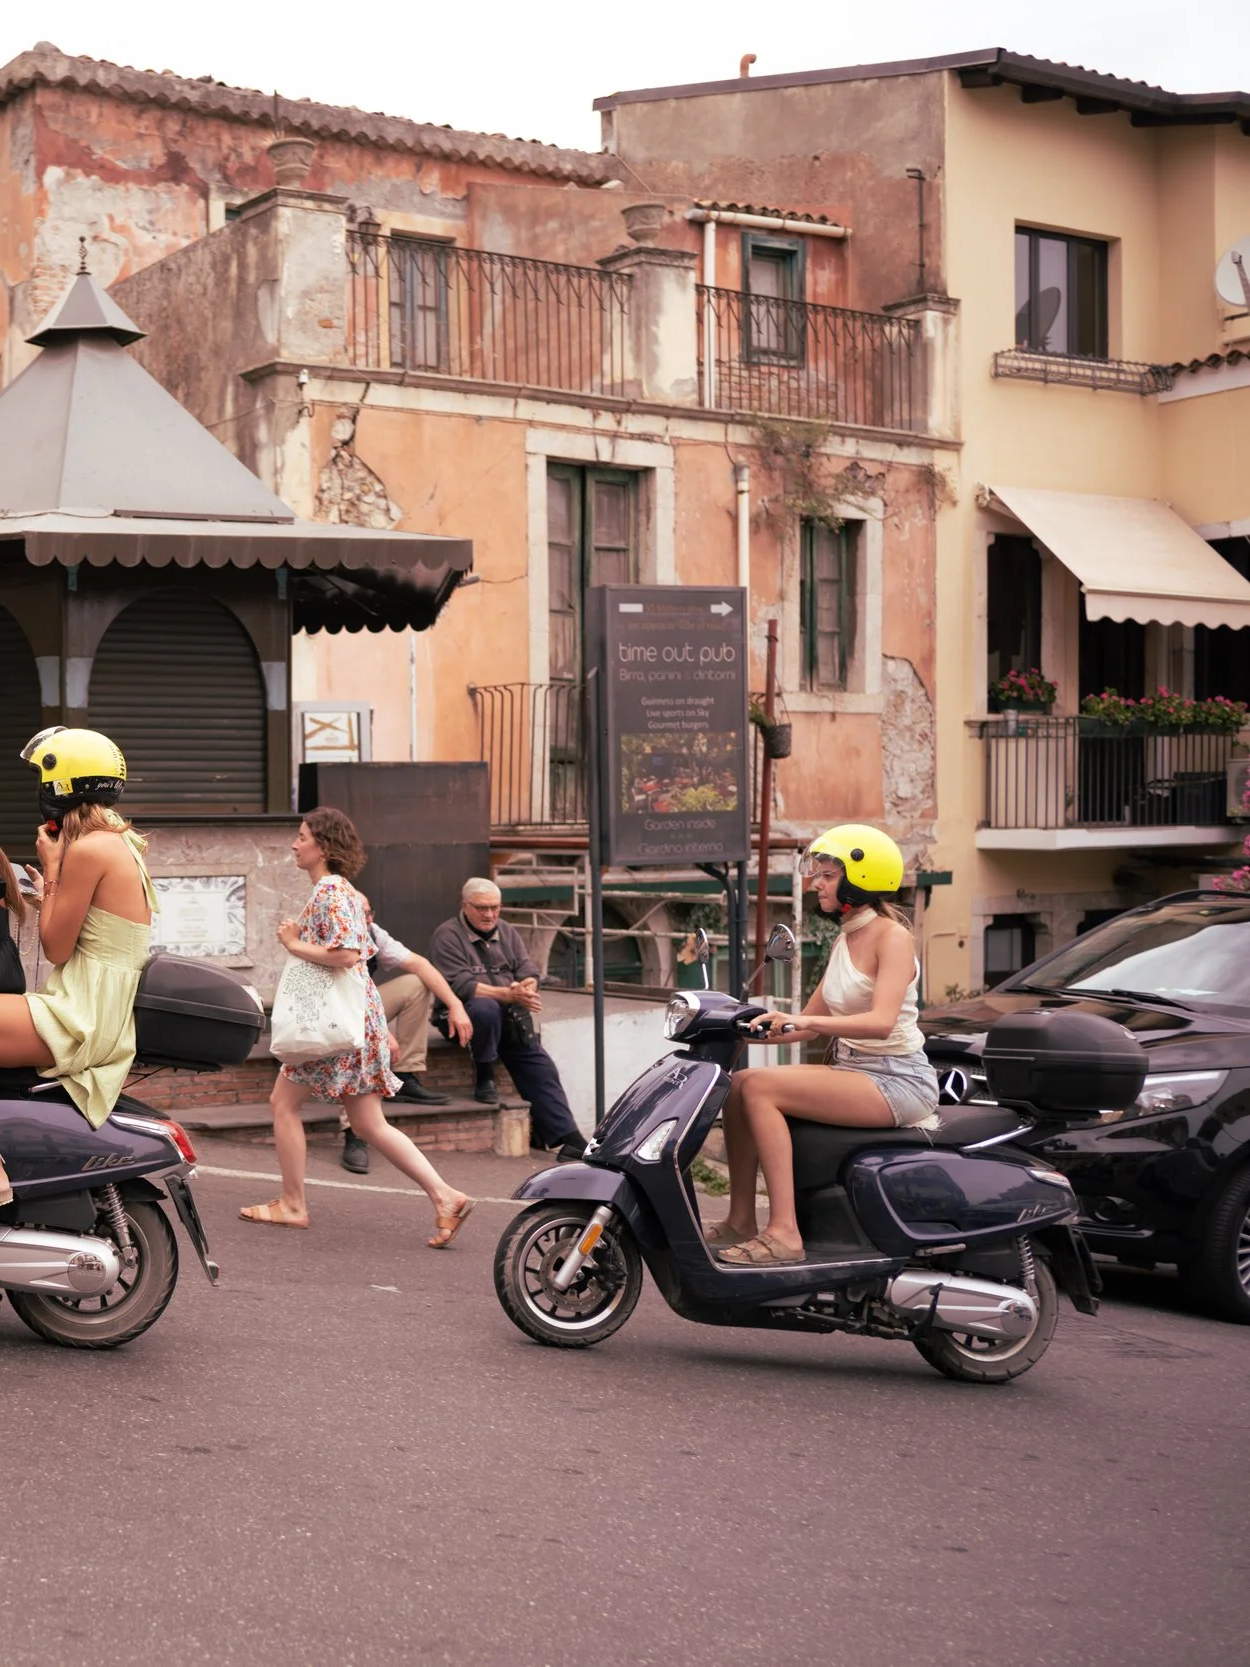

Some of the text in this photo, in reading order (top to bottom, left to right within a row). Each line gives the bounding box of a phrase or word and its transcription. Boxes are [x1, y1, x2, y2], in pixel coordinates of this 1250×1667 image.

[618, 642, 736, 666] time out pub
[648, 670, 682, 682] panini
[693, 669, 736, 681] dintorni
[687, 697, 714, 707] draught
[646, 709, 661, 717] Live
[662, 709, 685, 718] sports
[647, 721, 680, 729] Gourmet
[644, 819, 684, 831] Garden
